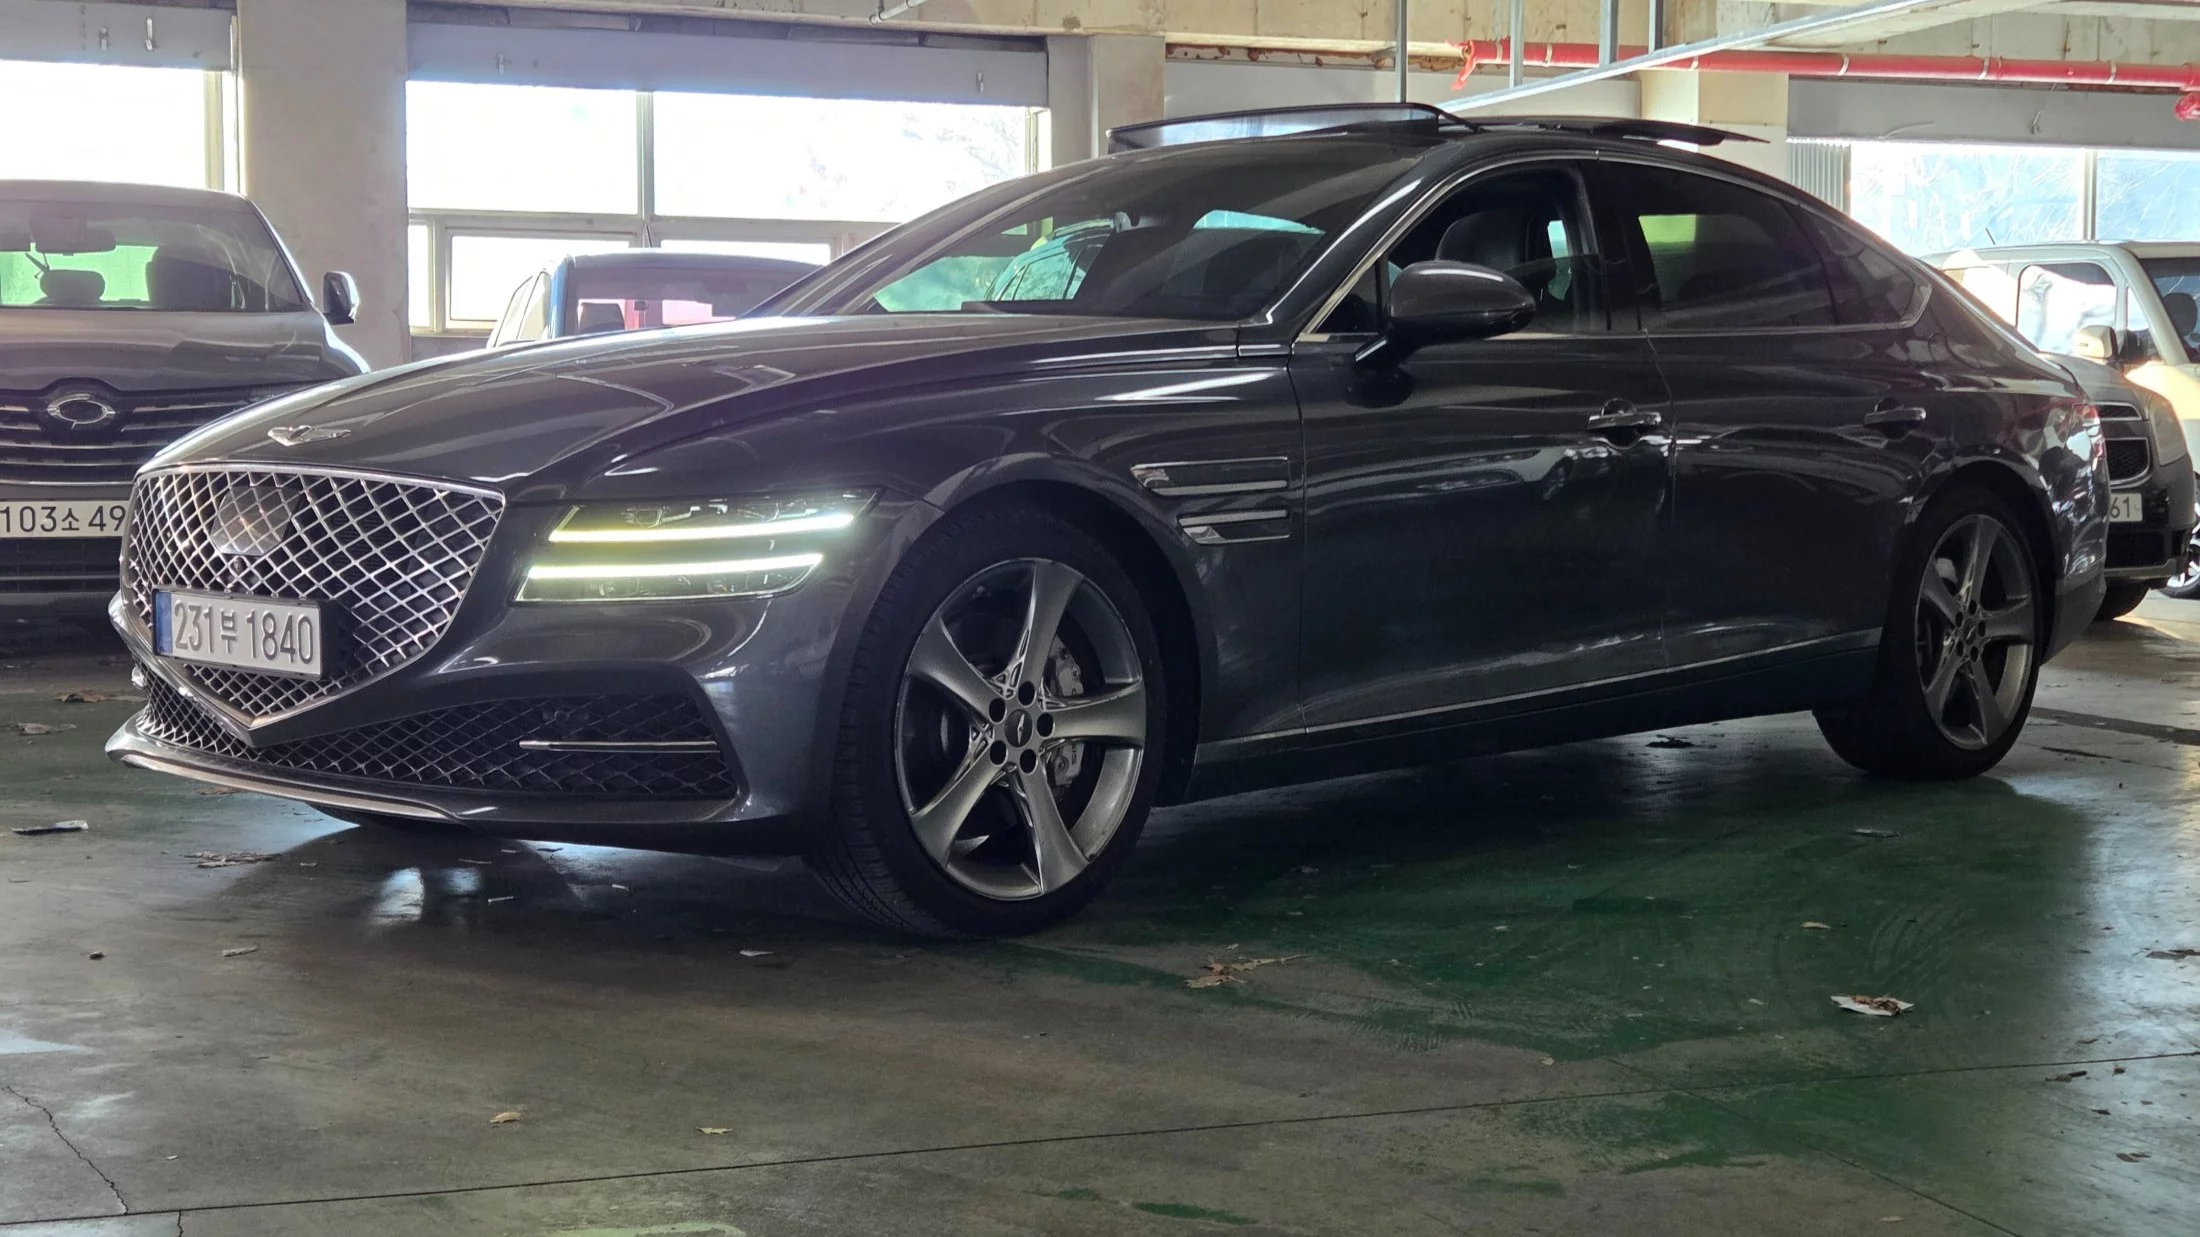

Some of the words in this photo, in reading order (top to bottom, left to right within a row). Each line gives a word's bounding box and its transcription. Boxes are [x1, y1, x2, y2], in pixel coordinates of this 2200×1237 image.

[0, 506, 80, 533] 103소
[2111, 496, 2130, 519] 61
[174, 601, 236, 654] 231부
[246, 610, 314, 665] 1840
